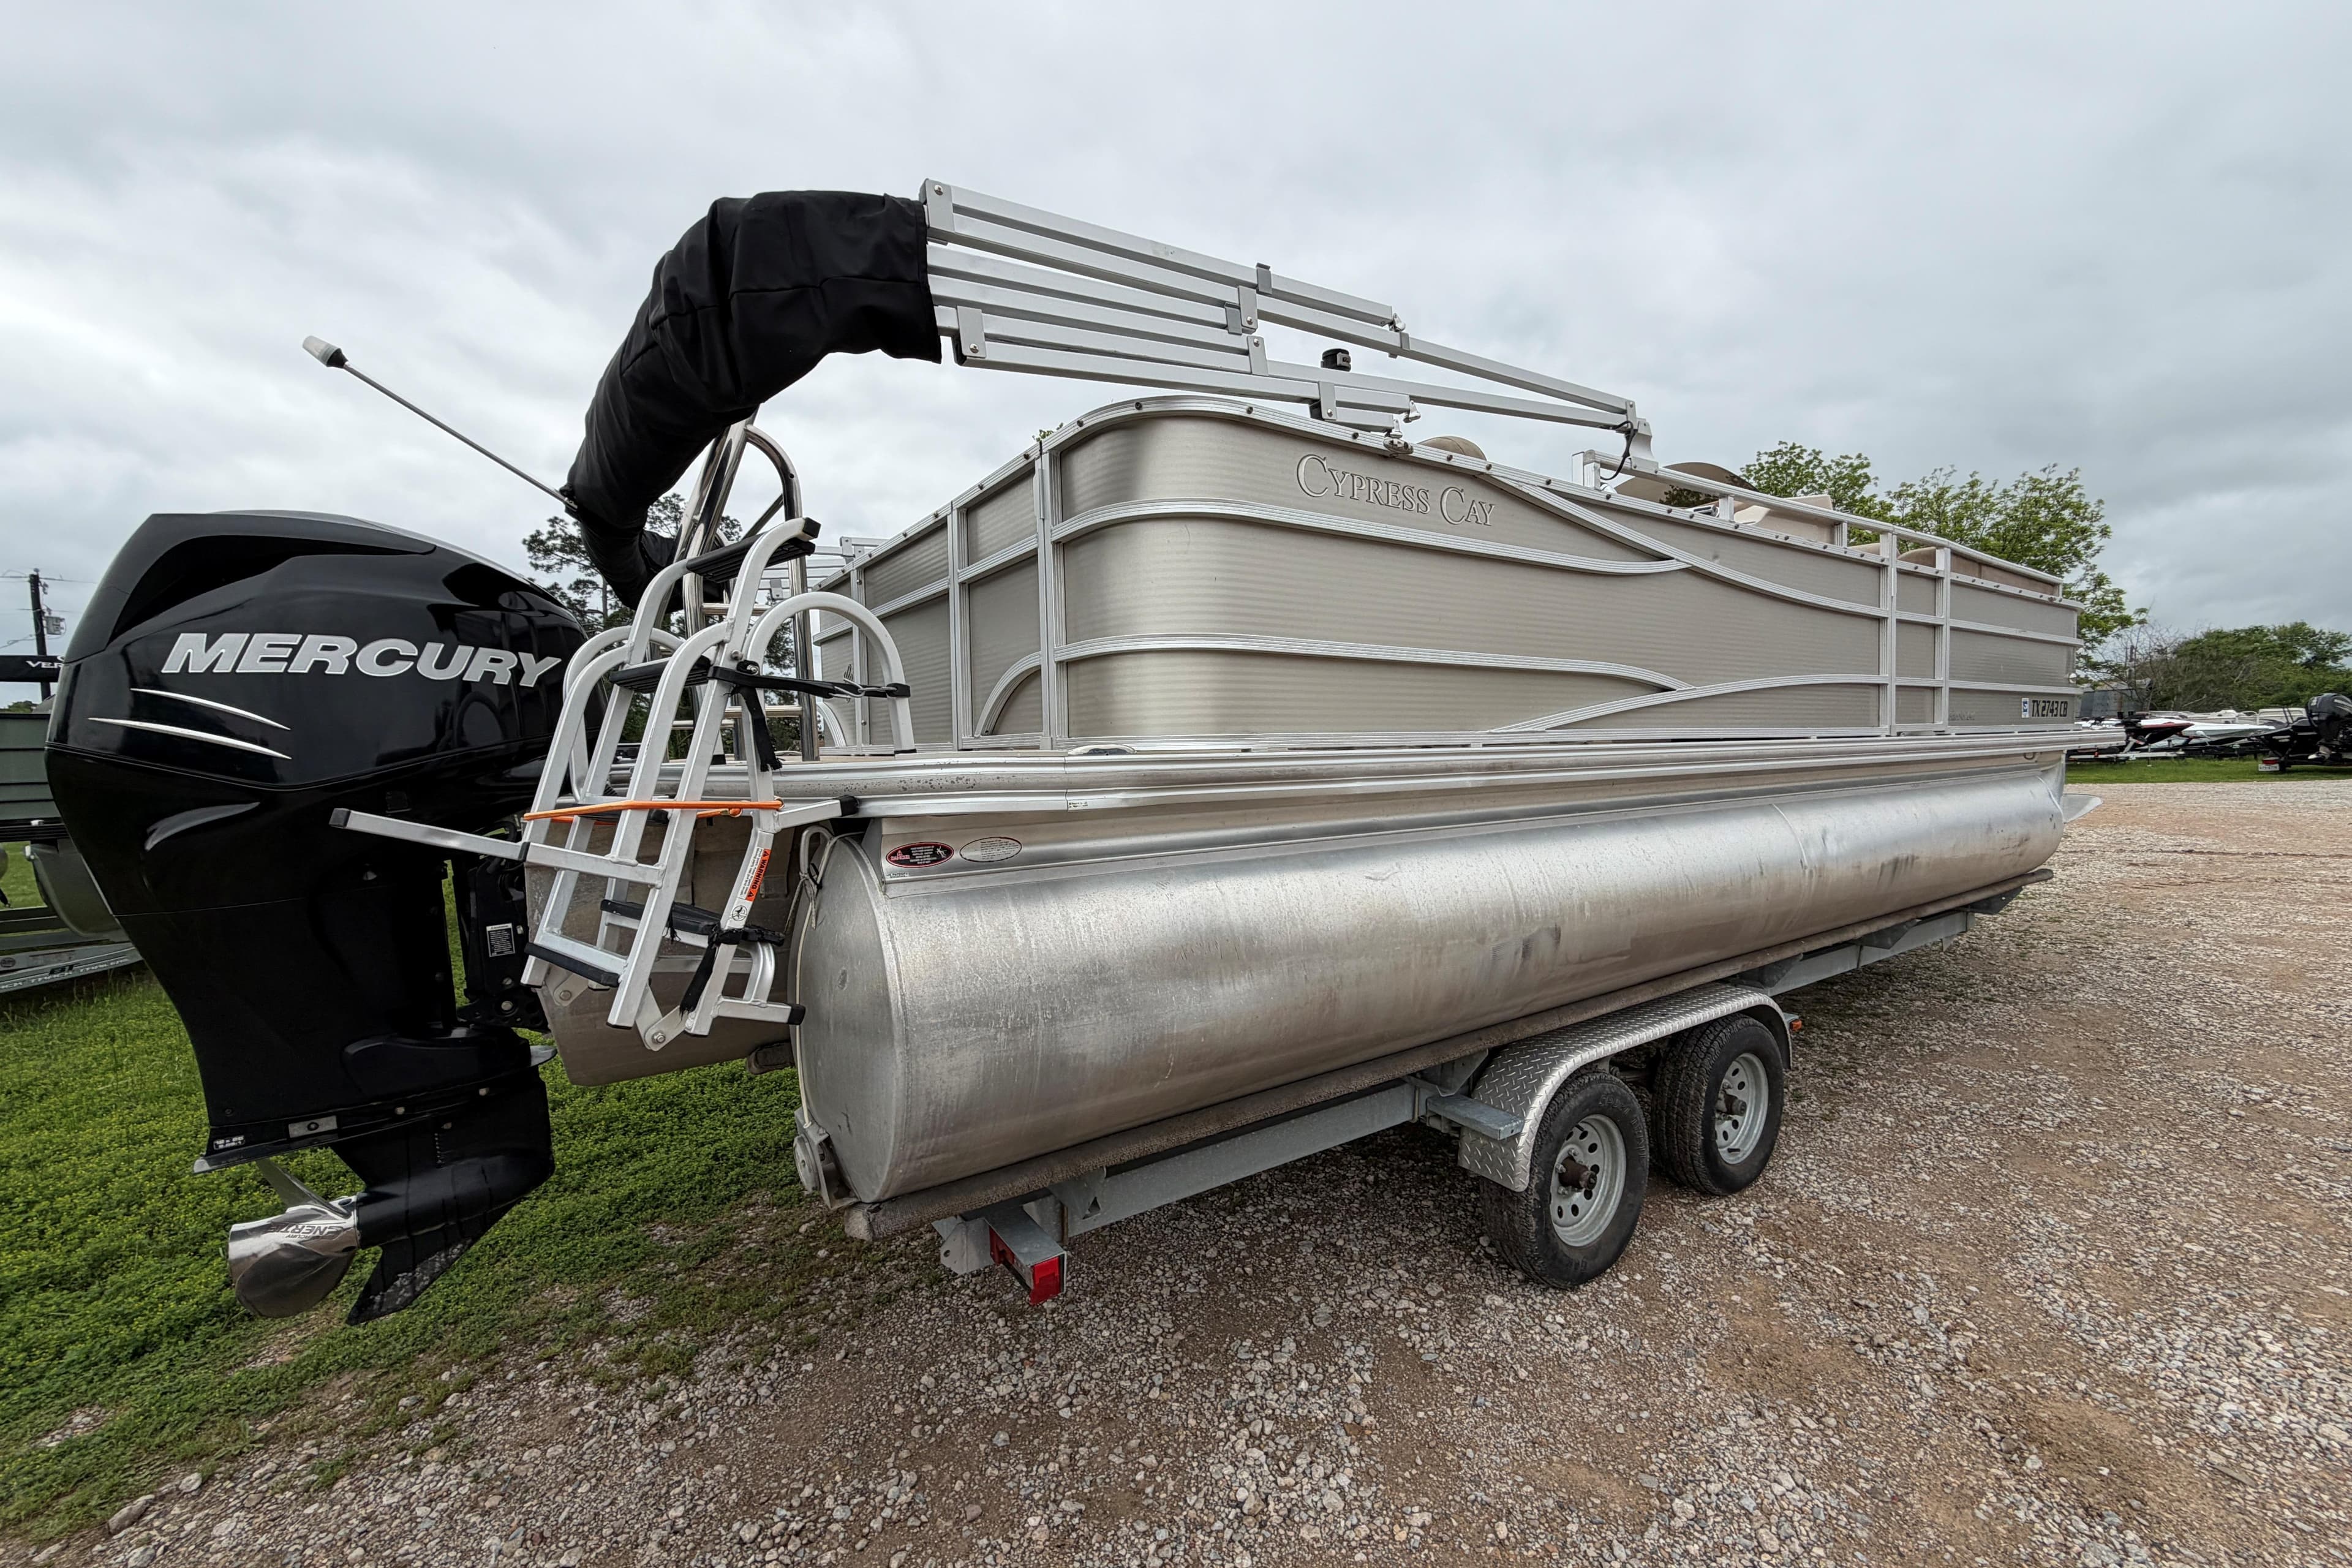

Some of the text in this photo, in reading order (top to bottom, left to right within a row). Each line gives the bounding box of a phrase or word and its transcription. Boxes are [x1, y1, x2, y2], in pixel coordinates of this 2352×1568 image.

[161, 632, 562, 687] MERCURY
[2032, 700, 2040, 717] TX
[2041, 700, 2059, 717] 2743
[2059, 701, 2068, 717] CB
[752, 859, 767, 890] WARNING
